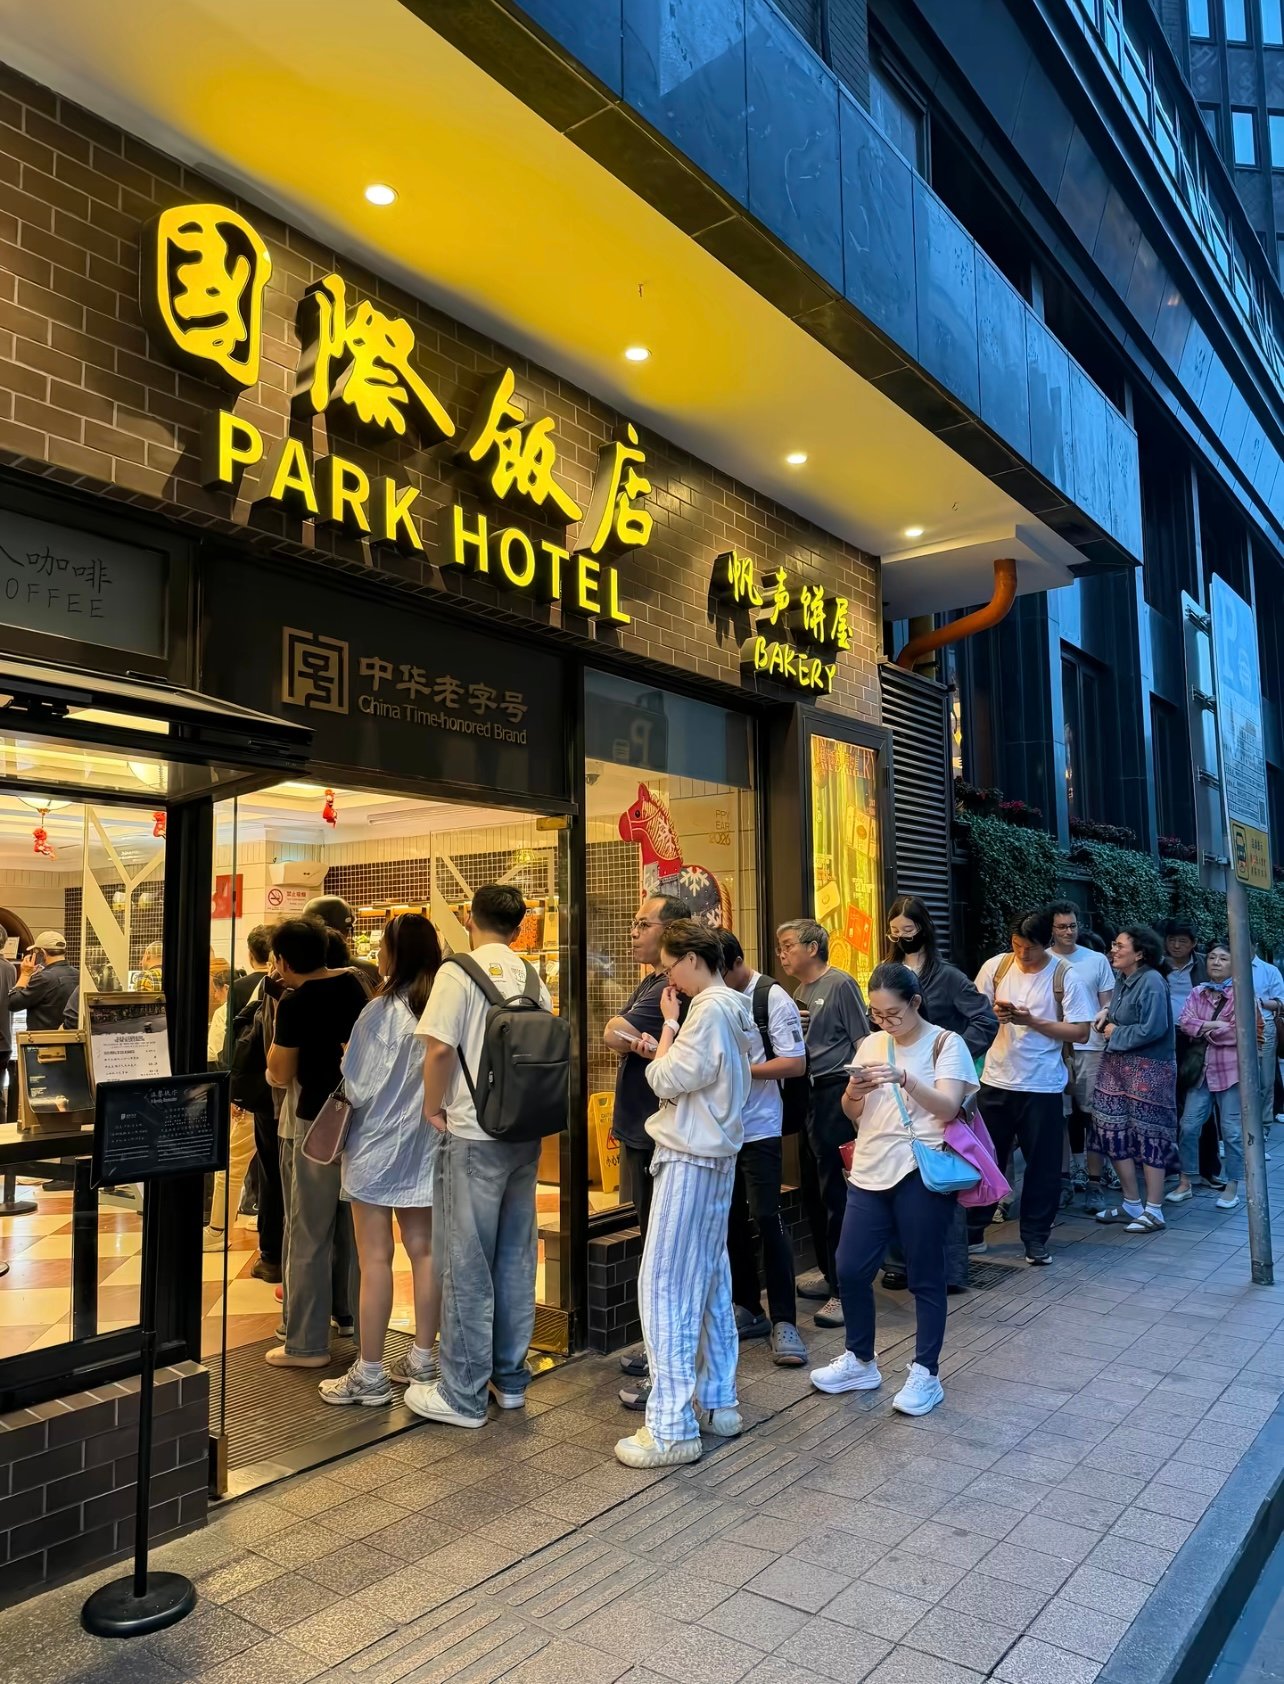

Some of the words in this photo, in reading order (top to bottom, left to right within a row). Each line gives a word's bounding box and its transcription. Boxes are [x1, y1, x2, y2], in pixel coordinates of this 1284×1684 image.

[218, 409, 424, 551] PARK
[454, 505, 631, 624] HOTEL
[358, 656, 529, 724] 中华老字号
[754, 635, 837, 694] BAKERY
[357, 694, 400, 720] China
[402, 704, 491, 738] Time-honored
[493, 722, 528, 745] Brand
